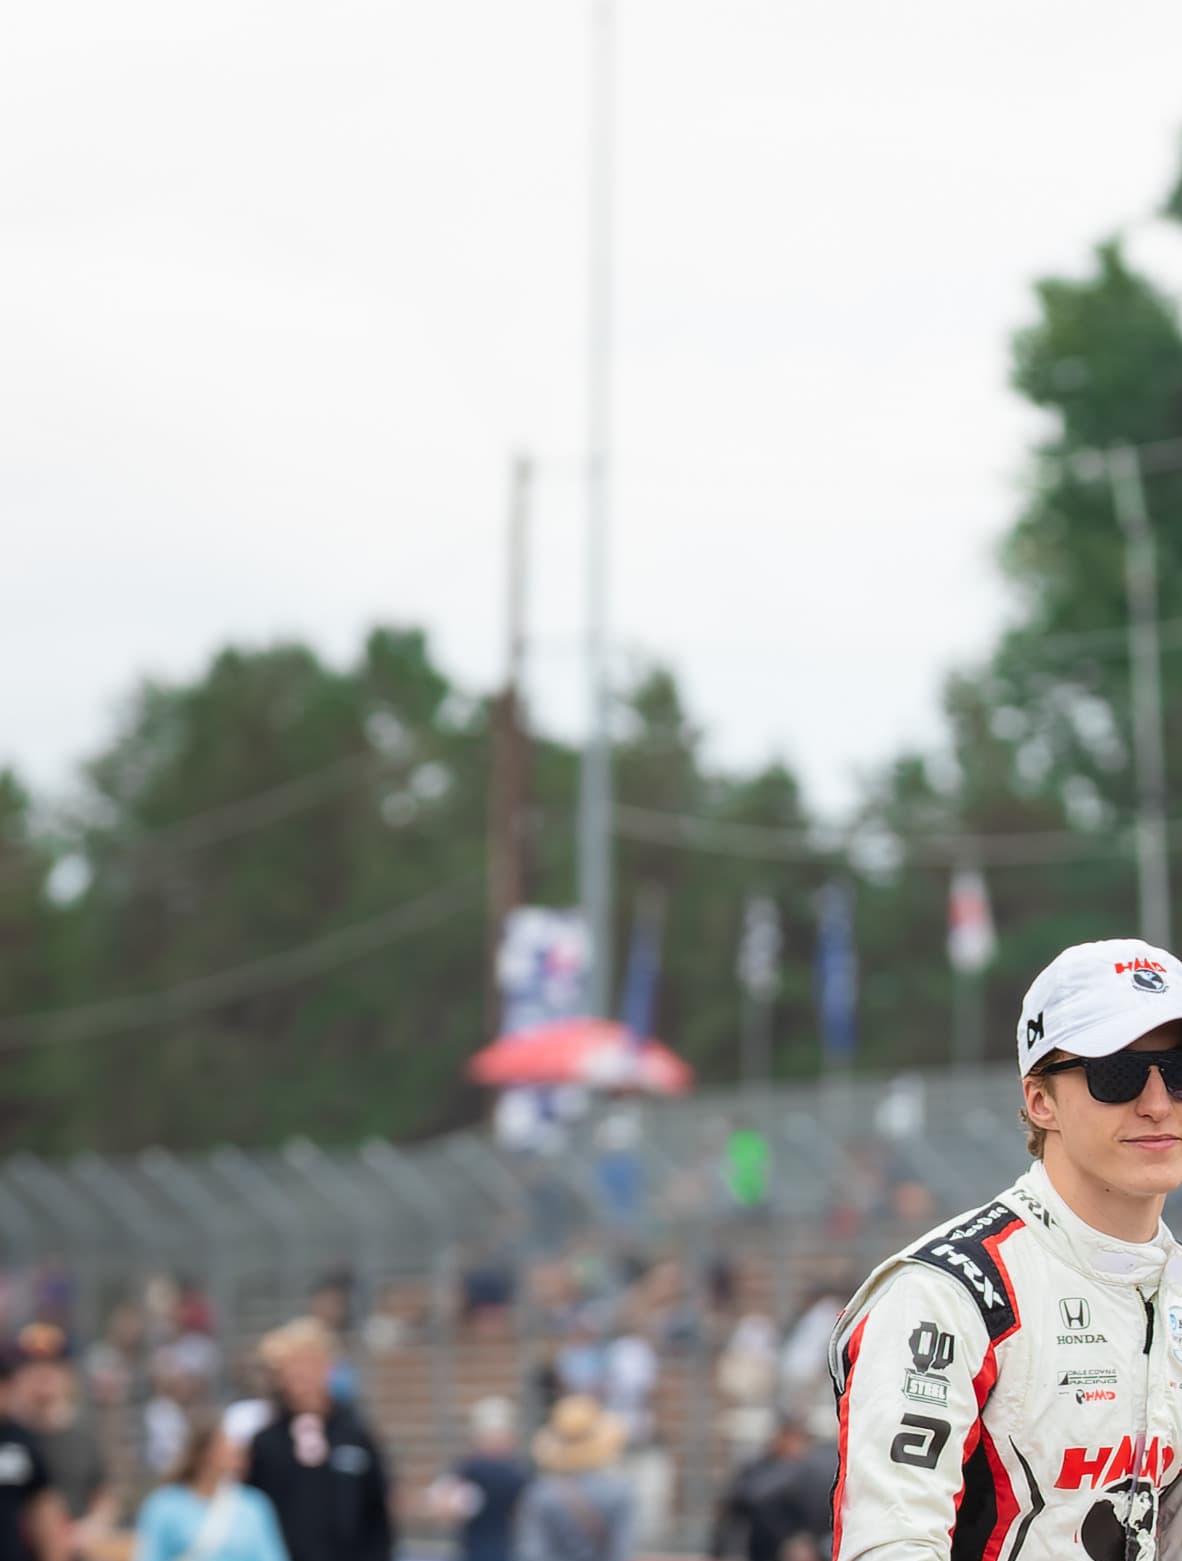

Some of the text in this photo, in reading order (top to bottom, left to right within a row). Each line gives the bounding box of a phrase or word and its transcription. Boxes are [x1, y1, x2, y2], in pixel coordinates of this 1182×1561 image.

[930, 1243, 1006, 1310] HRX
[1056, 1334, 1108, 1345] HONDA
[908, 1379, 947, 1400] STEEL
[1085, 1389, 1117, 1402] HMD
